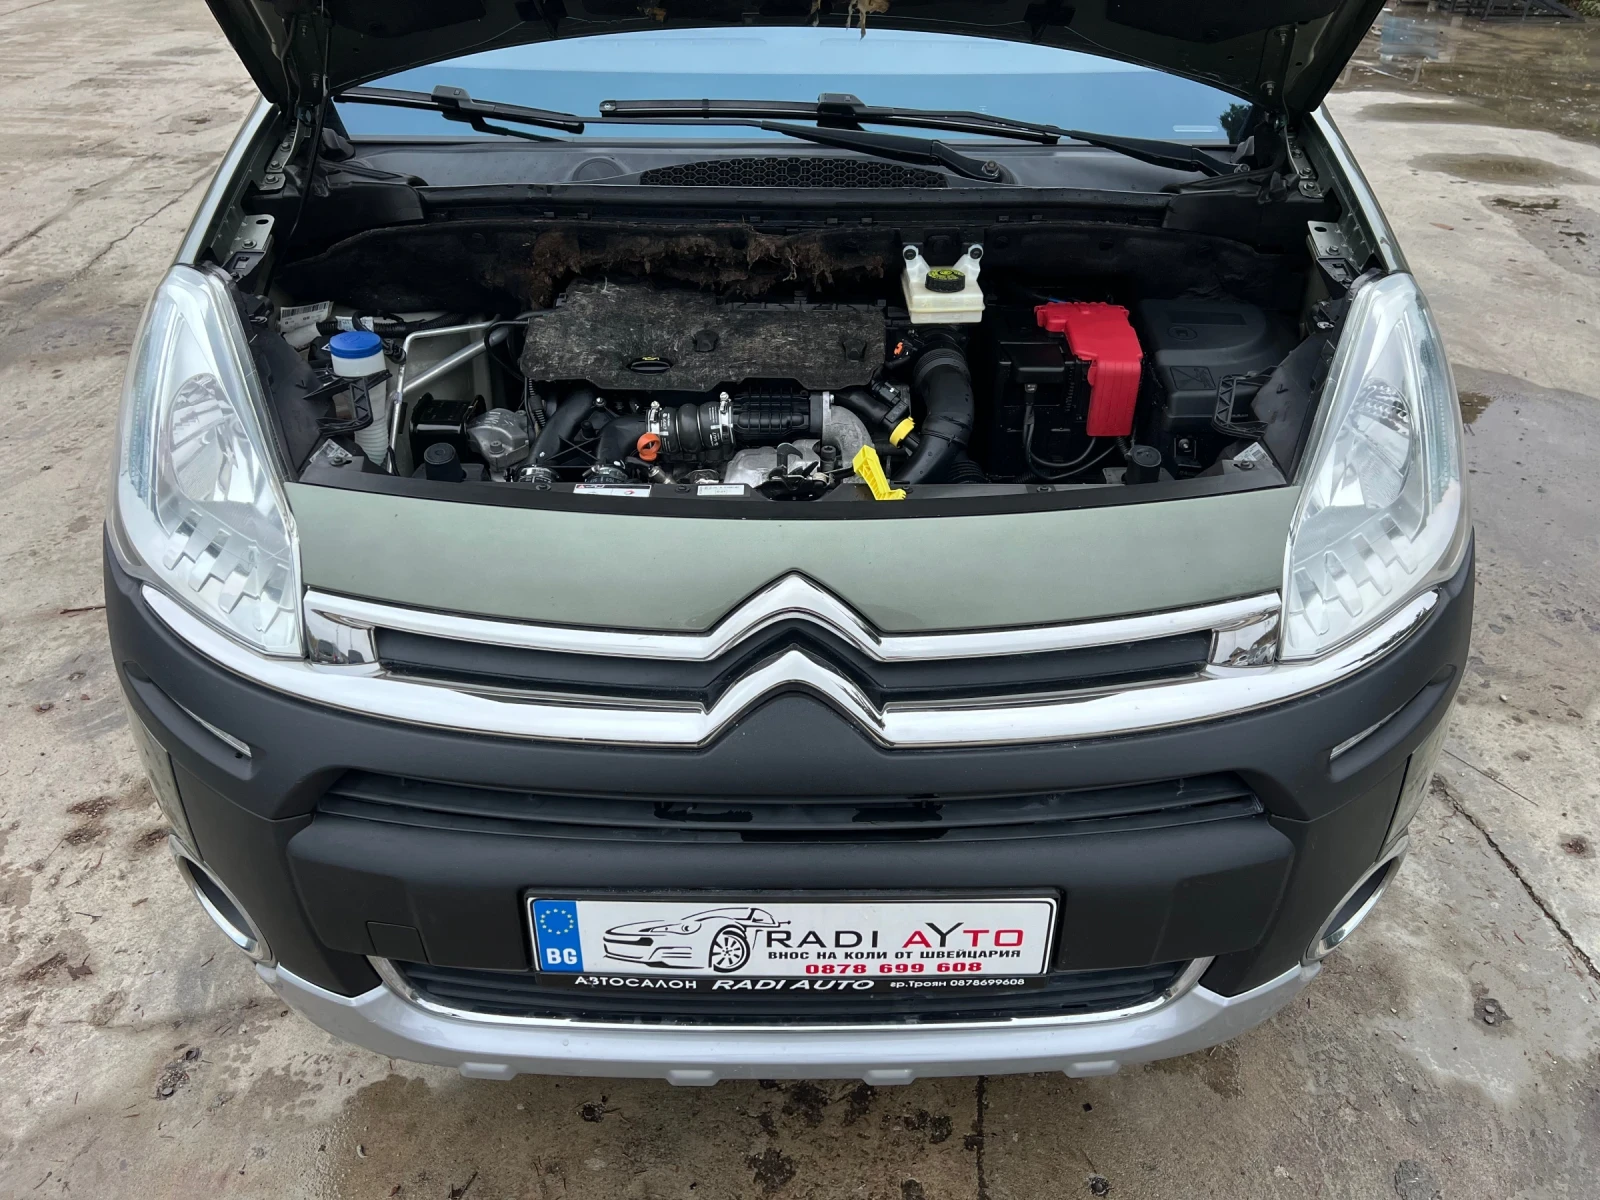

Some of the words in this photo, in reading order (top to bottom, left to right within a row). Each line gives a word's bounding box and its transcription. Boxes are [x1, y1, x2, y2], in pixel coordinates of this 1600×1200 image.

[766, 930, 878, 948] RADI
[546, 948, 577, 965] BG
[768, 951, 809, 960] ВНОС
[817, 951, 837, 960] НА
[844, 951, 887, 960] КОЛИ
[895, 951, 913, 959] ОТ
[920, 949, 1021, 959] ШВЕЙЦАРИЯ
[805, 964, 867, 974] 0878
[879, 963, 925, 973] 699
[937, 962, 982, 972] 608
[712, 979, 787, 990] RADI
[789, 979, 875, 990] AUTO
